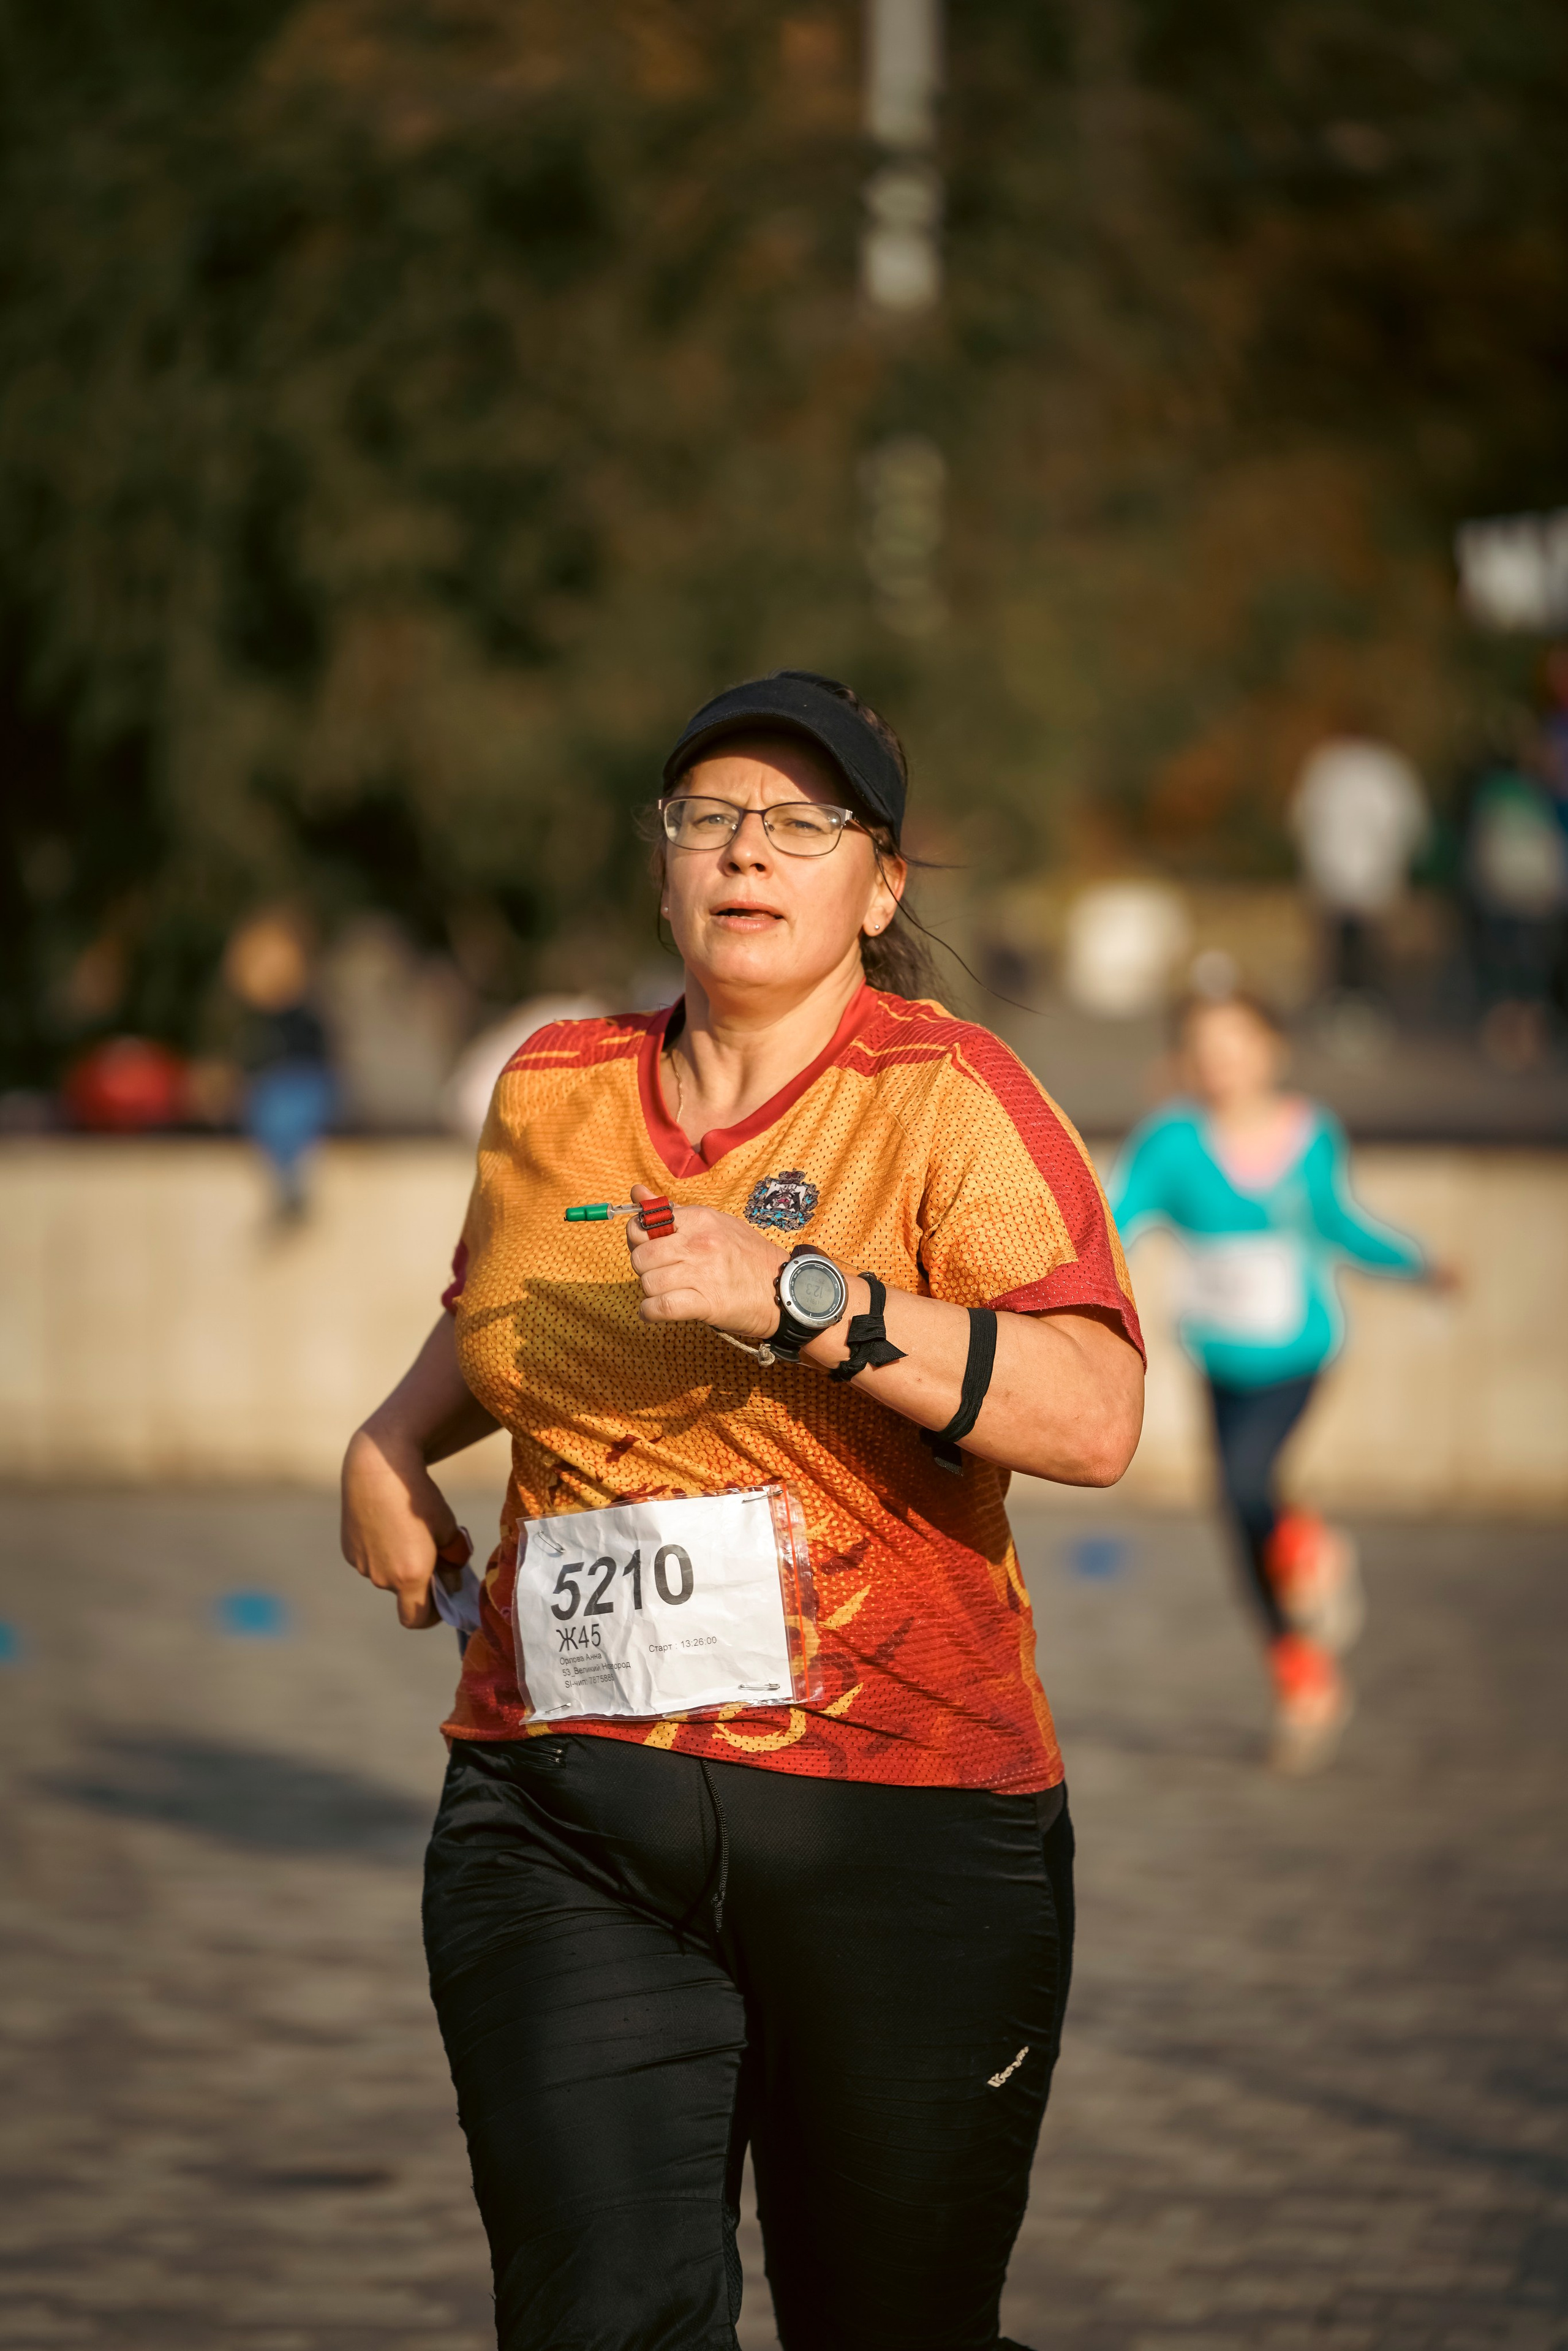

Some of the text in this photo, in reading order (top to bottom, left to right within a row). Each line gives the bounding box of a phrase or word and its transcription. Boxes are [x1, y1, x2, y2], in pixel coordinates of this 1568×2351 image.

[551, 1544, 694, 1621] 5210
[556, 1623, 601, 1652] Ж45
[649, 1643, 673, 1653] Старт
[680, 1636, 717, 1648] 13:26:00
[559, 1656, 585, 1666] Орлова
[562, 1664, 601, 1677] 53_Великий
[565, 1674, 615, 1688] SI-чип: 7875885
